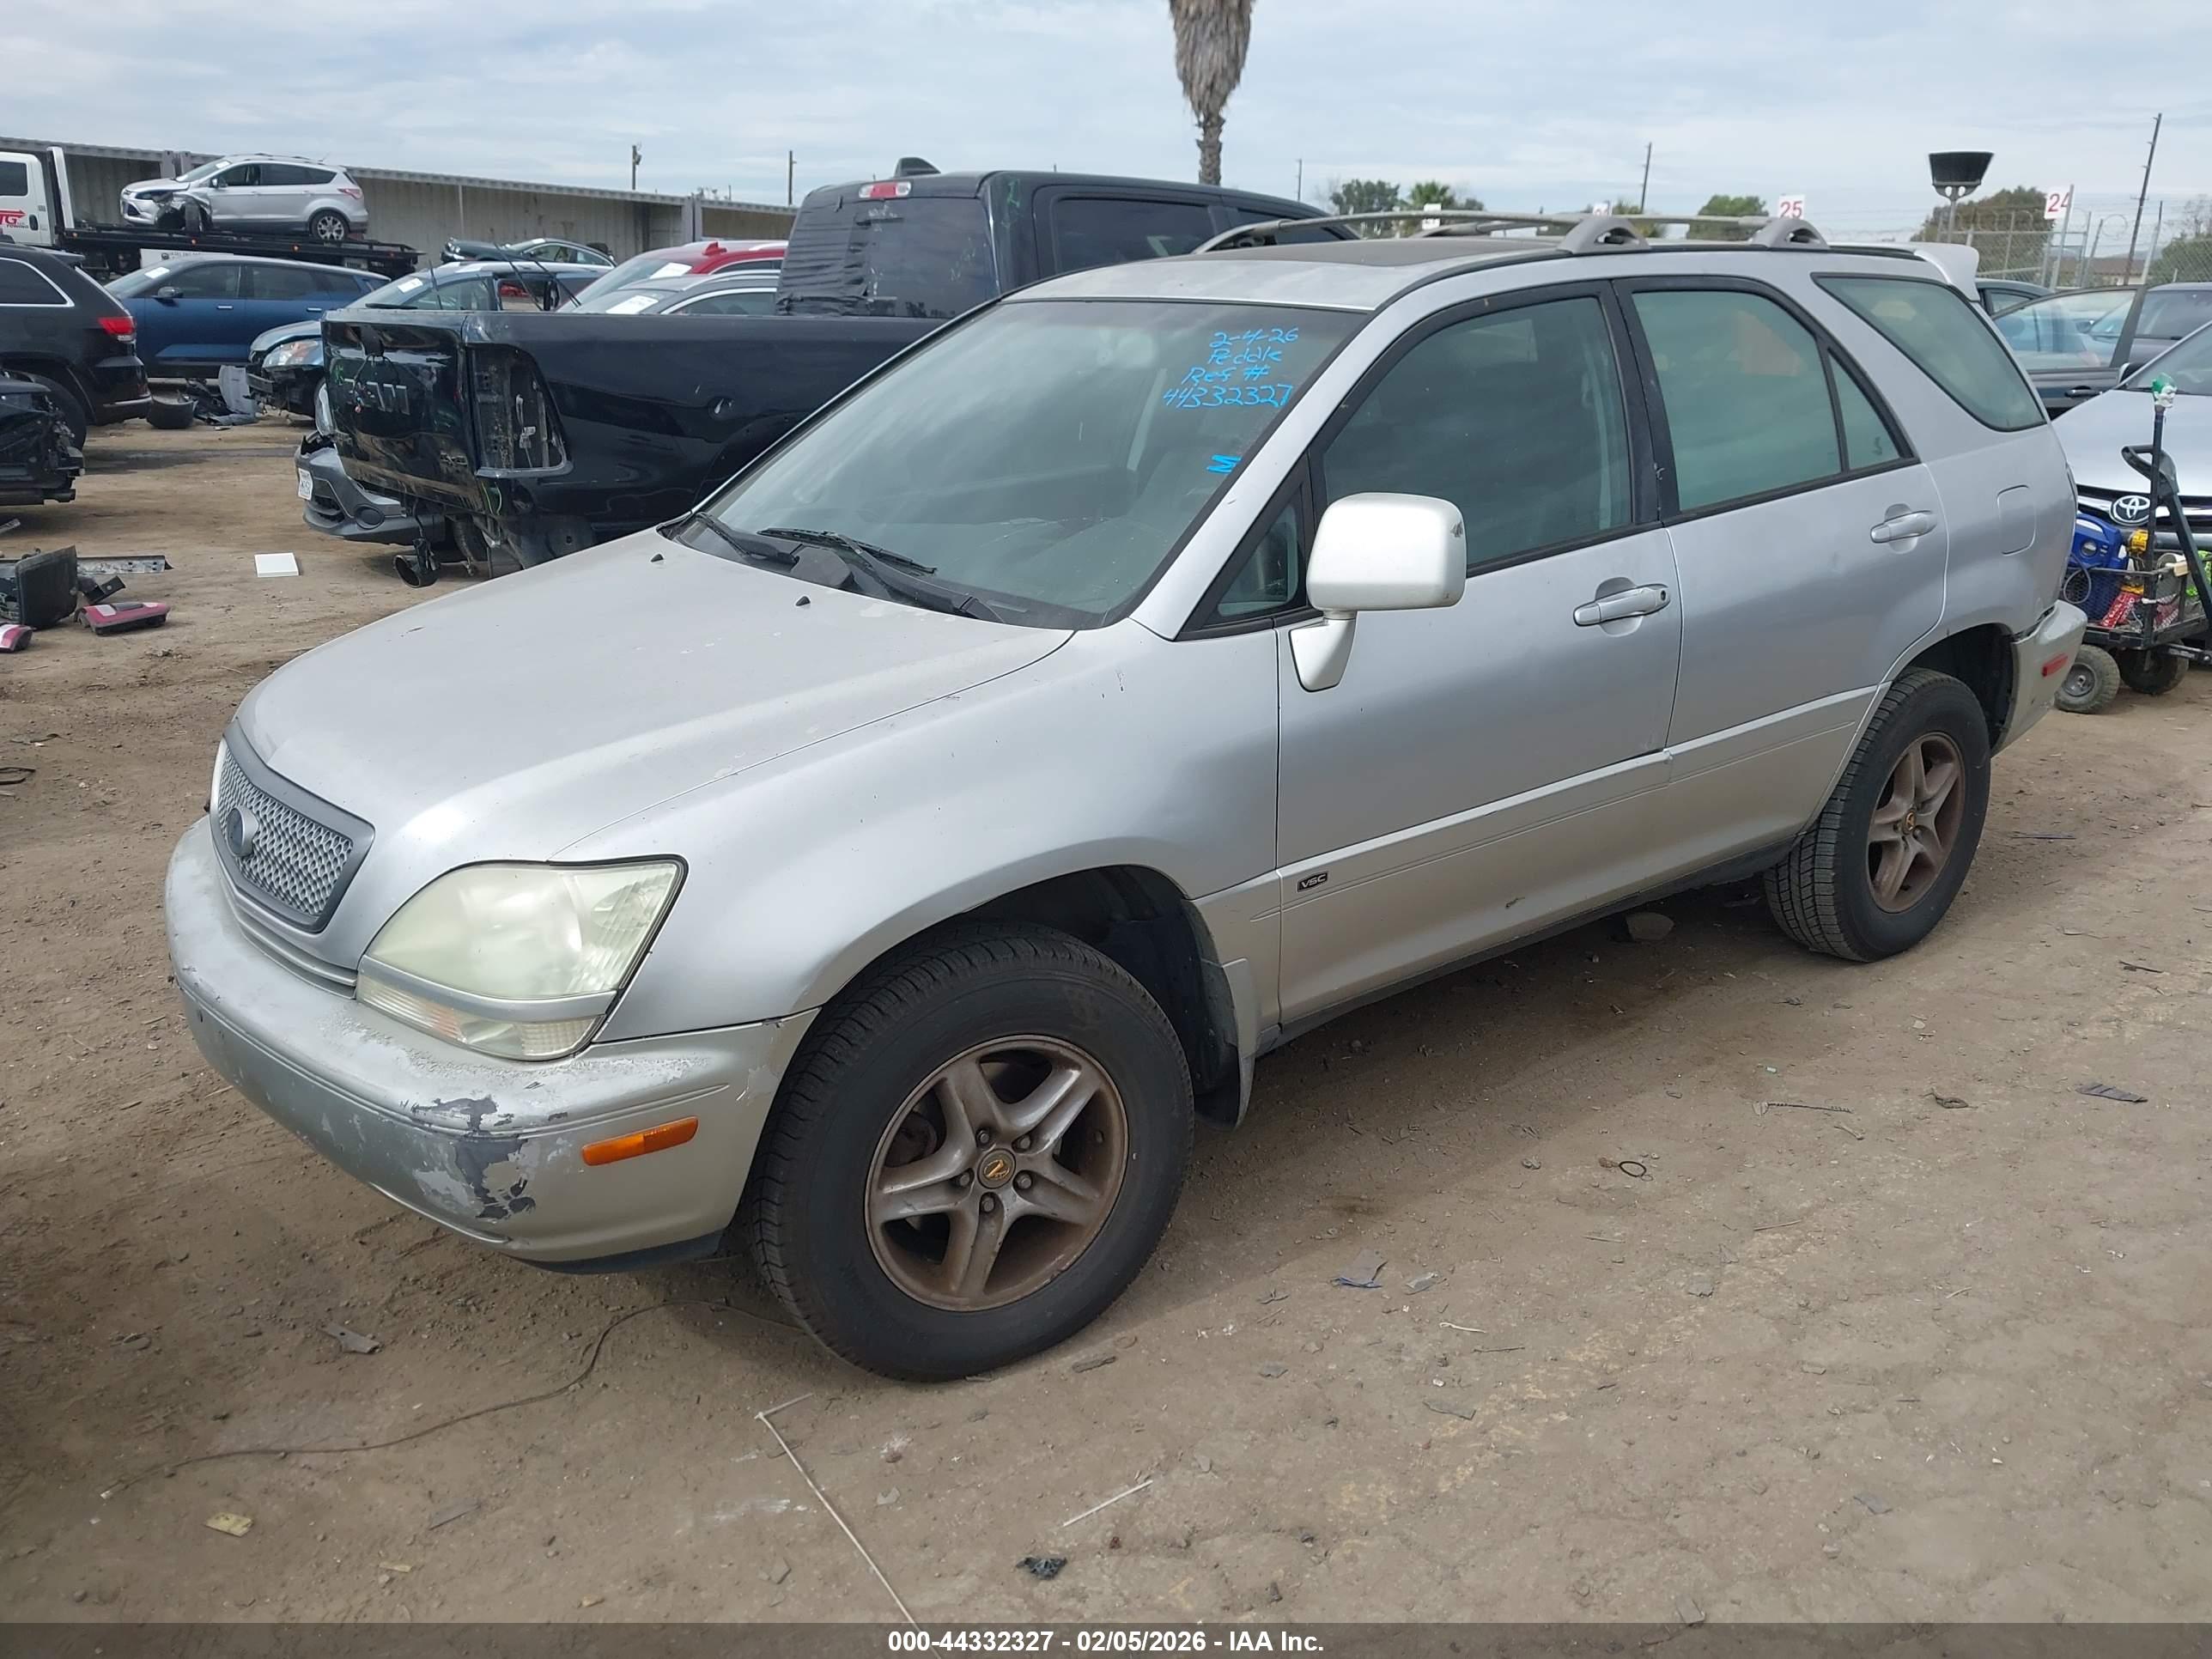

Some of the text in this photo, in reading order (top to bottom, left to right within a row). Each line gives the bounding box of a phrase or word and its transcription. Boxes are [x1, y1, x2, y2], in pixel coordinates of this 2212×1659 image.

[1779, 200, 1803, 220] 25
[2047, 192, 2070, 212] 24
[1209, 327, 1299, 348] 2-4-26
[1243, 364, 1271, 381] #
[1163, 383, 1293, 409] 44332327
[1301, 873, 1327, 889] VSC
